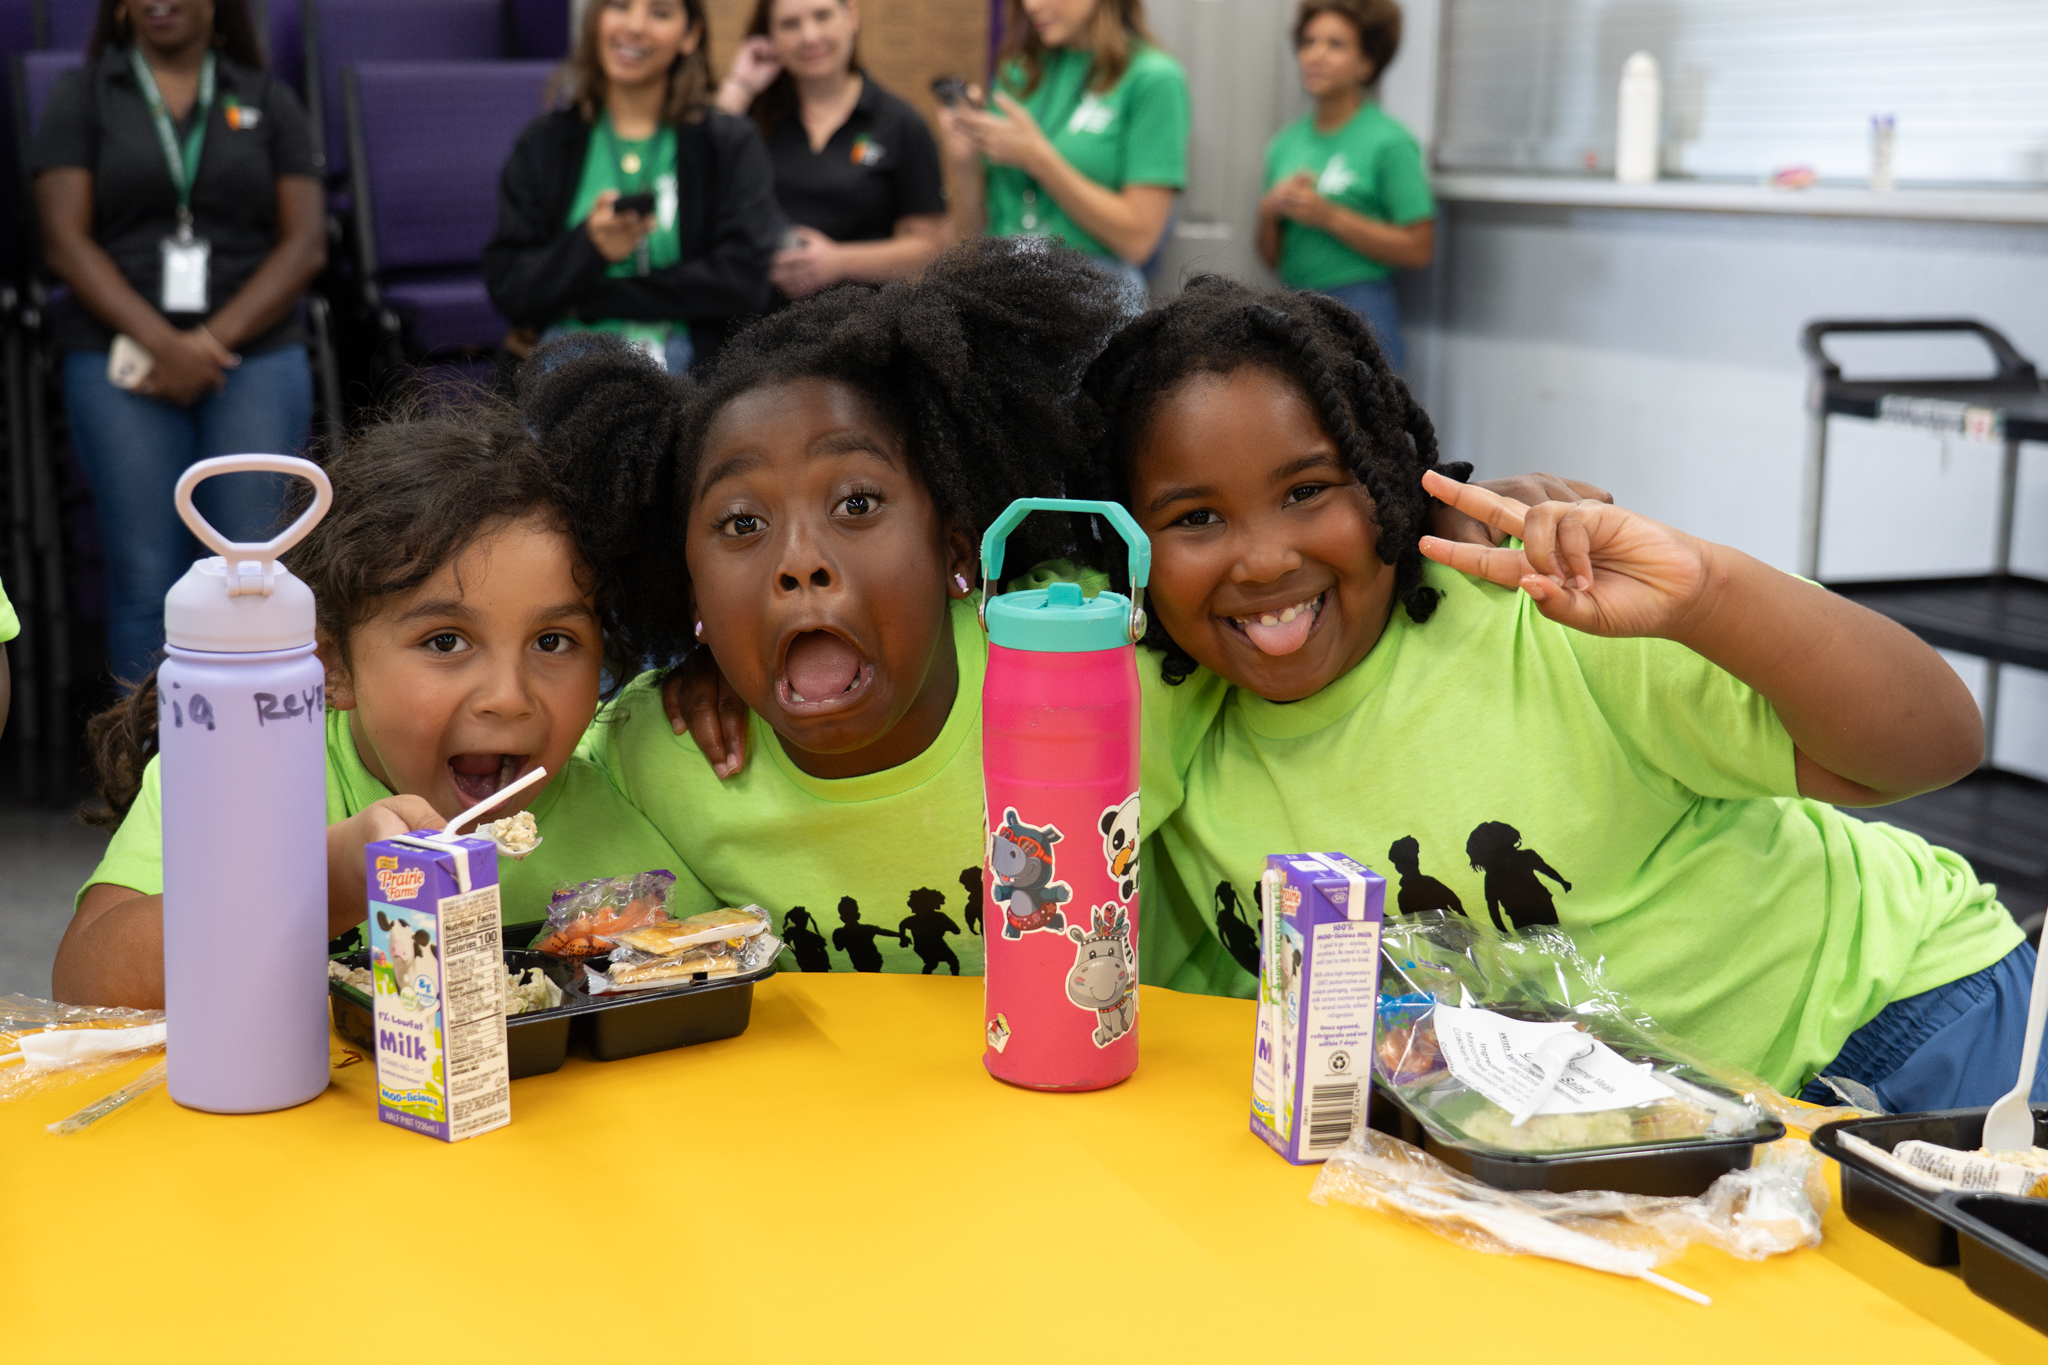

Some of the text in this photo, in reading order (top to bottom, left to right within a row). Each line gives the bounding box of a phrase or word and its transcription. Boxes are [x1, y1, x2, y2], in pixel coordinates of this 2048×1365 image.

[379, 869, 424, 888] Prairie
[387, 886, 417, 899] Farms
[446, 912, 497, 932] Nutrition Facts
[1333, 922, 1354, 931] 100%
[446, 940, 477, 954] Calories
[478, 930, 498, 945] 100
[1274, 894, 1282, 982] 100% RECYCLABLE
[378, 1011, 424, 1030] 1% Lowfat
[1336, 1022, 1360, 1030] opened,
[380, 1028, 427, 1062] Milk
[1310, 1032, 1344, 1040] refrigerate
[1452, 1026, 1470, 1063] Crackers,
[1560, 1076, 1594, 1095] Salad
[1595, 1077, 1616, 1094] Meals
[385, 1111, 399, 1122] HALF
[400, 1116, 414, 1127] PINT
